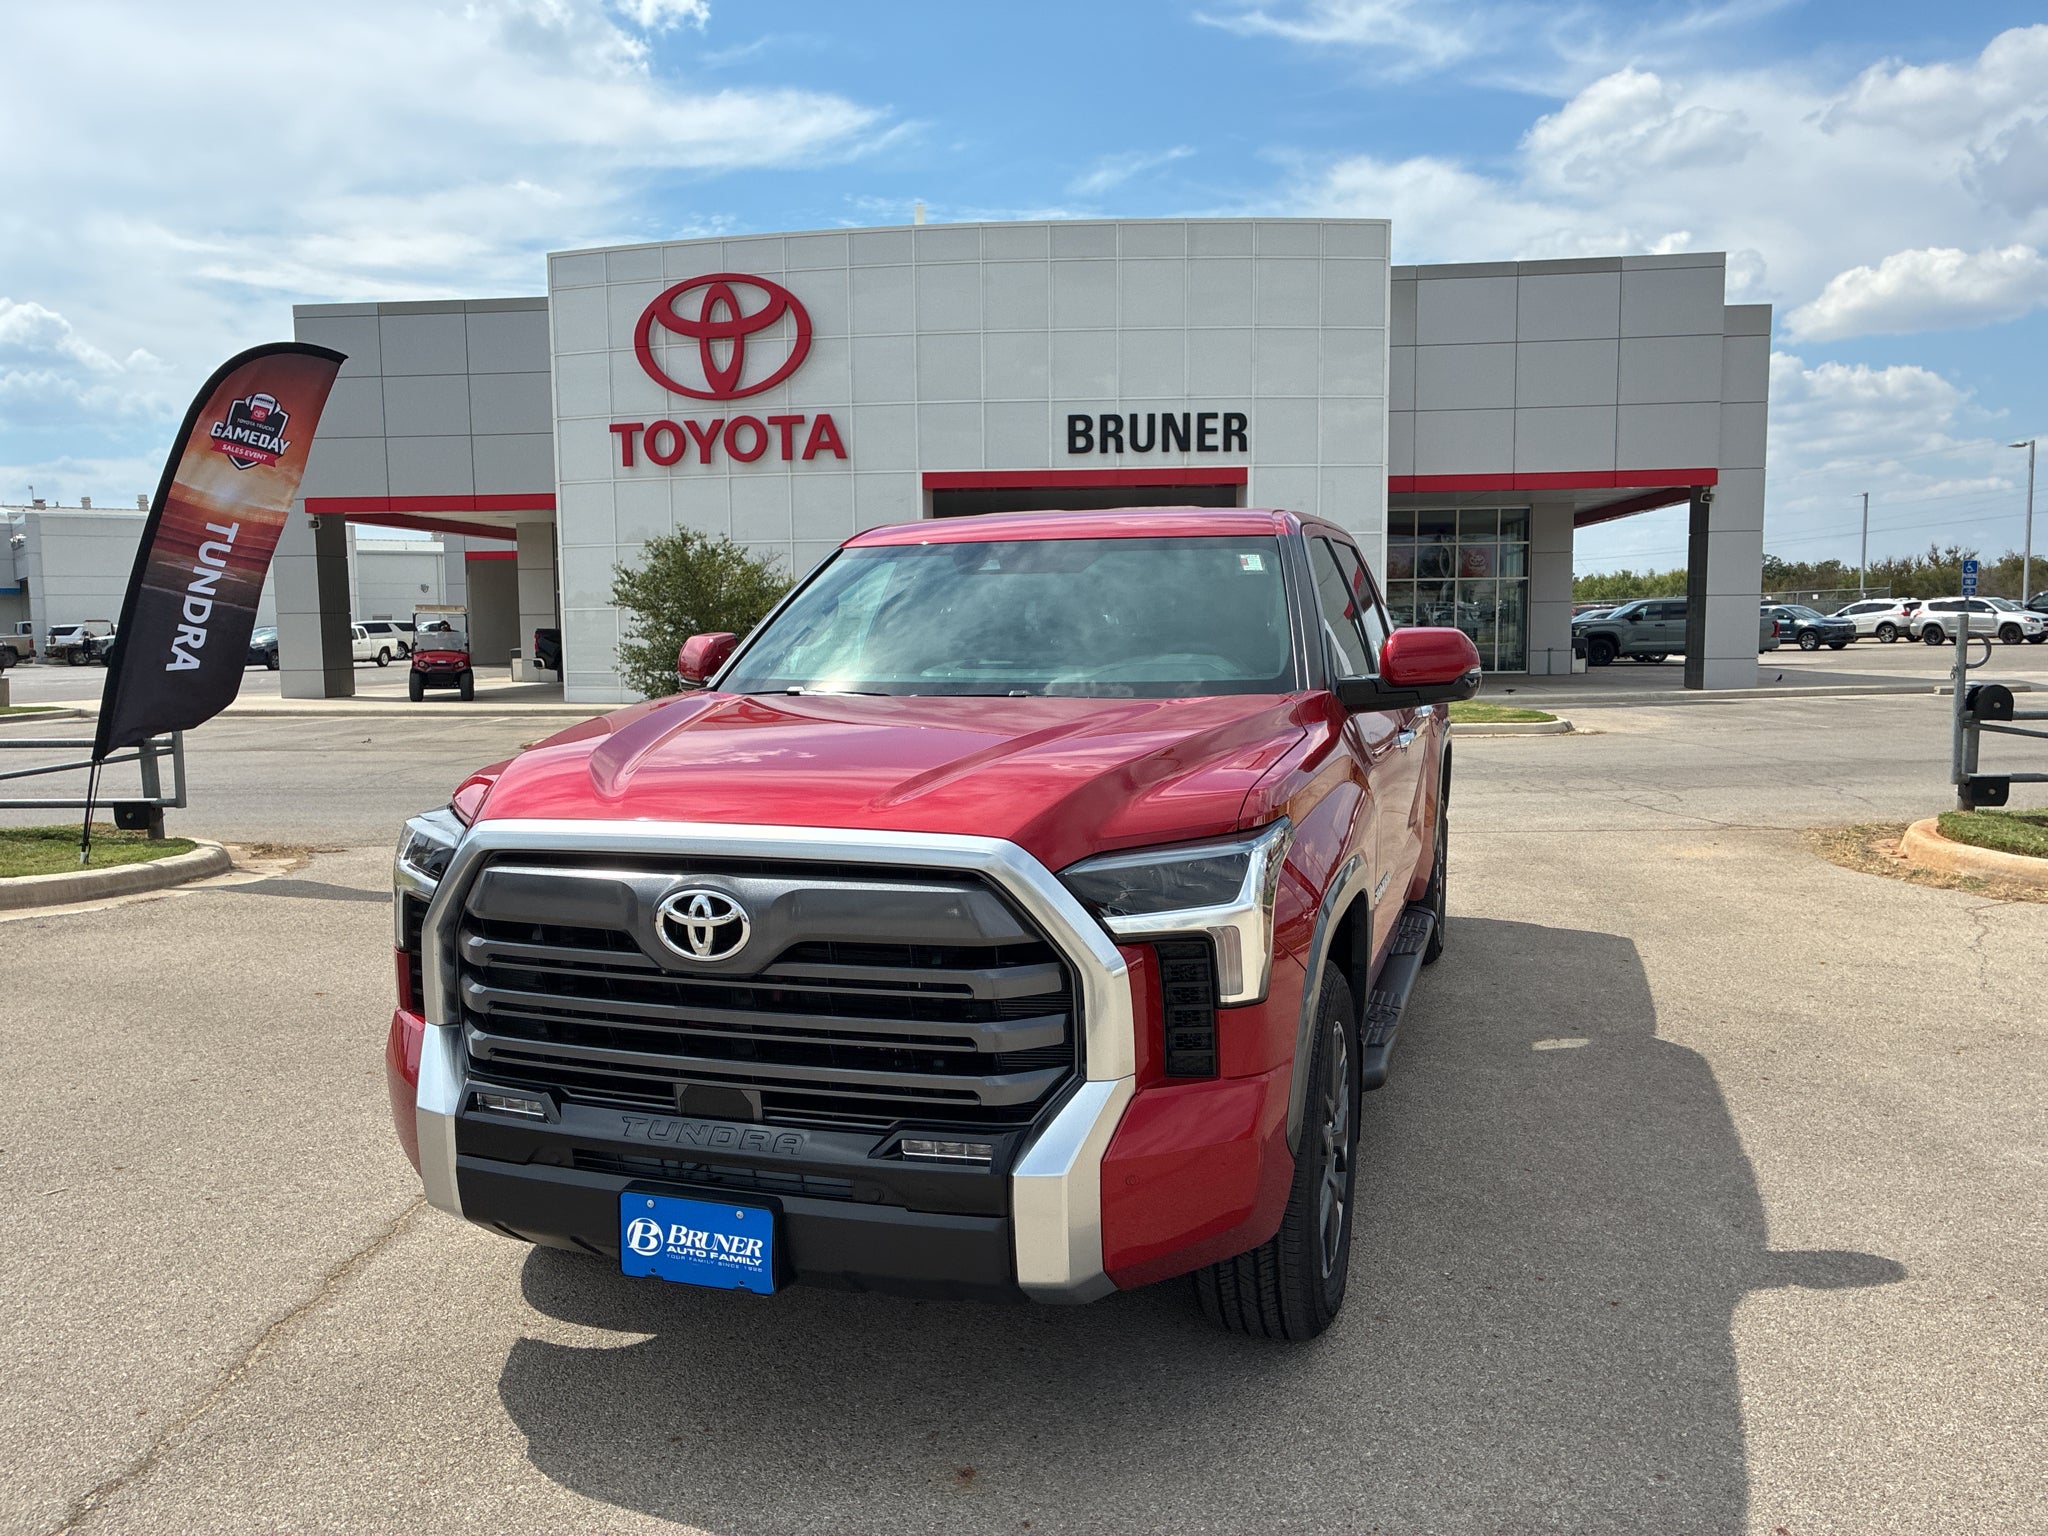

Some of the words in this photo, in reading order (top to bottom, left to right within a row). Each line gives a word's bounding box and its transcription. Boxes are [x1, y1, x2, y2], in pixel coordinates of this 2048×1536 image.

[211, 421, 291, 455] GAMEDAY
[237, 418, 255, 426] TOYOTA
[256, 423, 275, 432] TRUCKS
[609, 414, 848, 467] TOYOTA
[1067, 412, 1248, 454] BRUNER
[222, 444, 244, 455] SALES
[244, 451, 268, 460] EVENT
[166, 522, 239, 671] TUNDRA
[622, 1116, 804, 1155] TUNDRA
[666, 1224, 763, 1258] BRUNER
[667, 1246, 707, 1257] AUTO
[710, 1252, 763, 1266] FAMILY
[718, 1261, 740, 1269] SINCE
